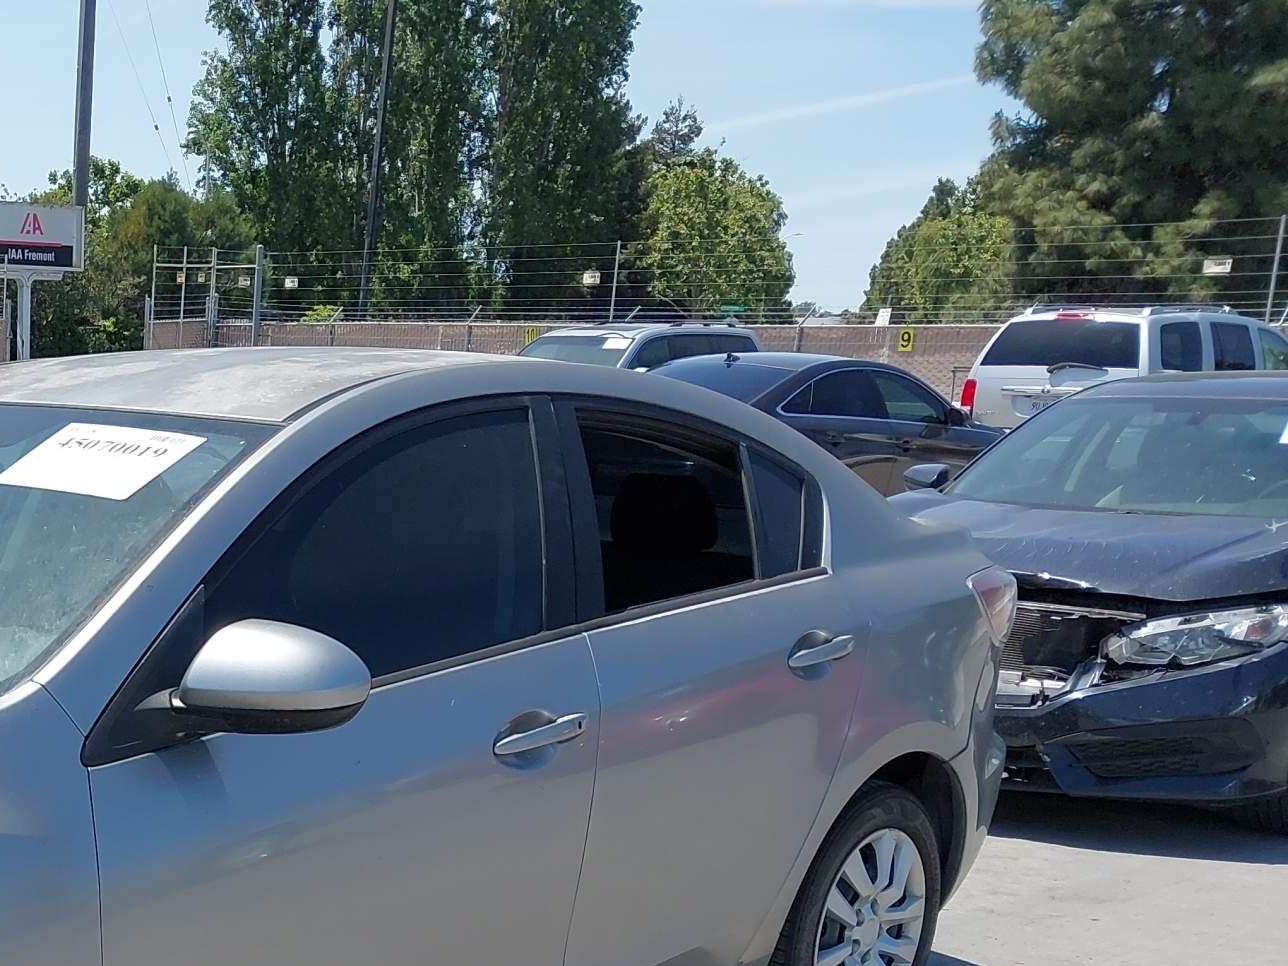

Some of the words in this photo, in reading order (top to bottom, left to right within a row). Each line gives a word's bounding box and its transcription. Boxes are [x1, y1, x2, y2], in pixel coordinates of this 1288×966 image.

[8, 248, 23, 260] IAA
[24, 249, 55, 262] Fremont
[900, 331, 911, 348] 9
[58, 437, 169, 457] 45070019
